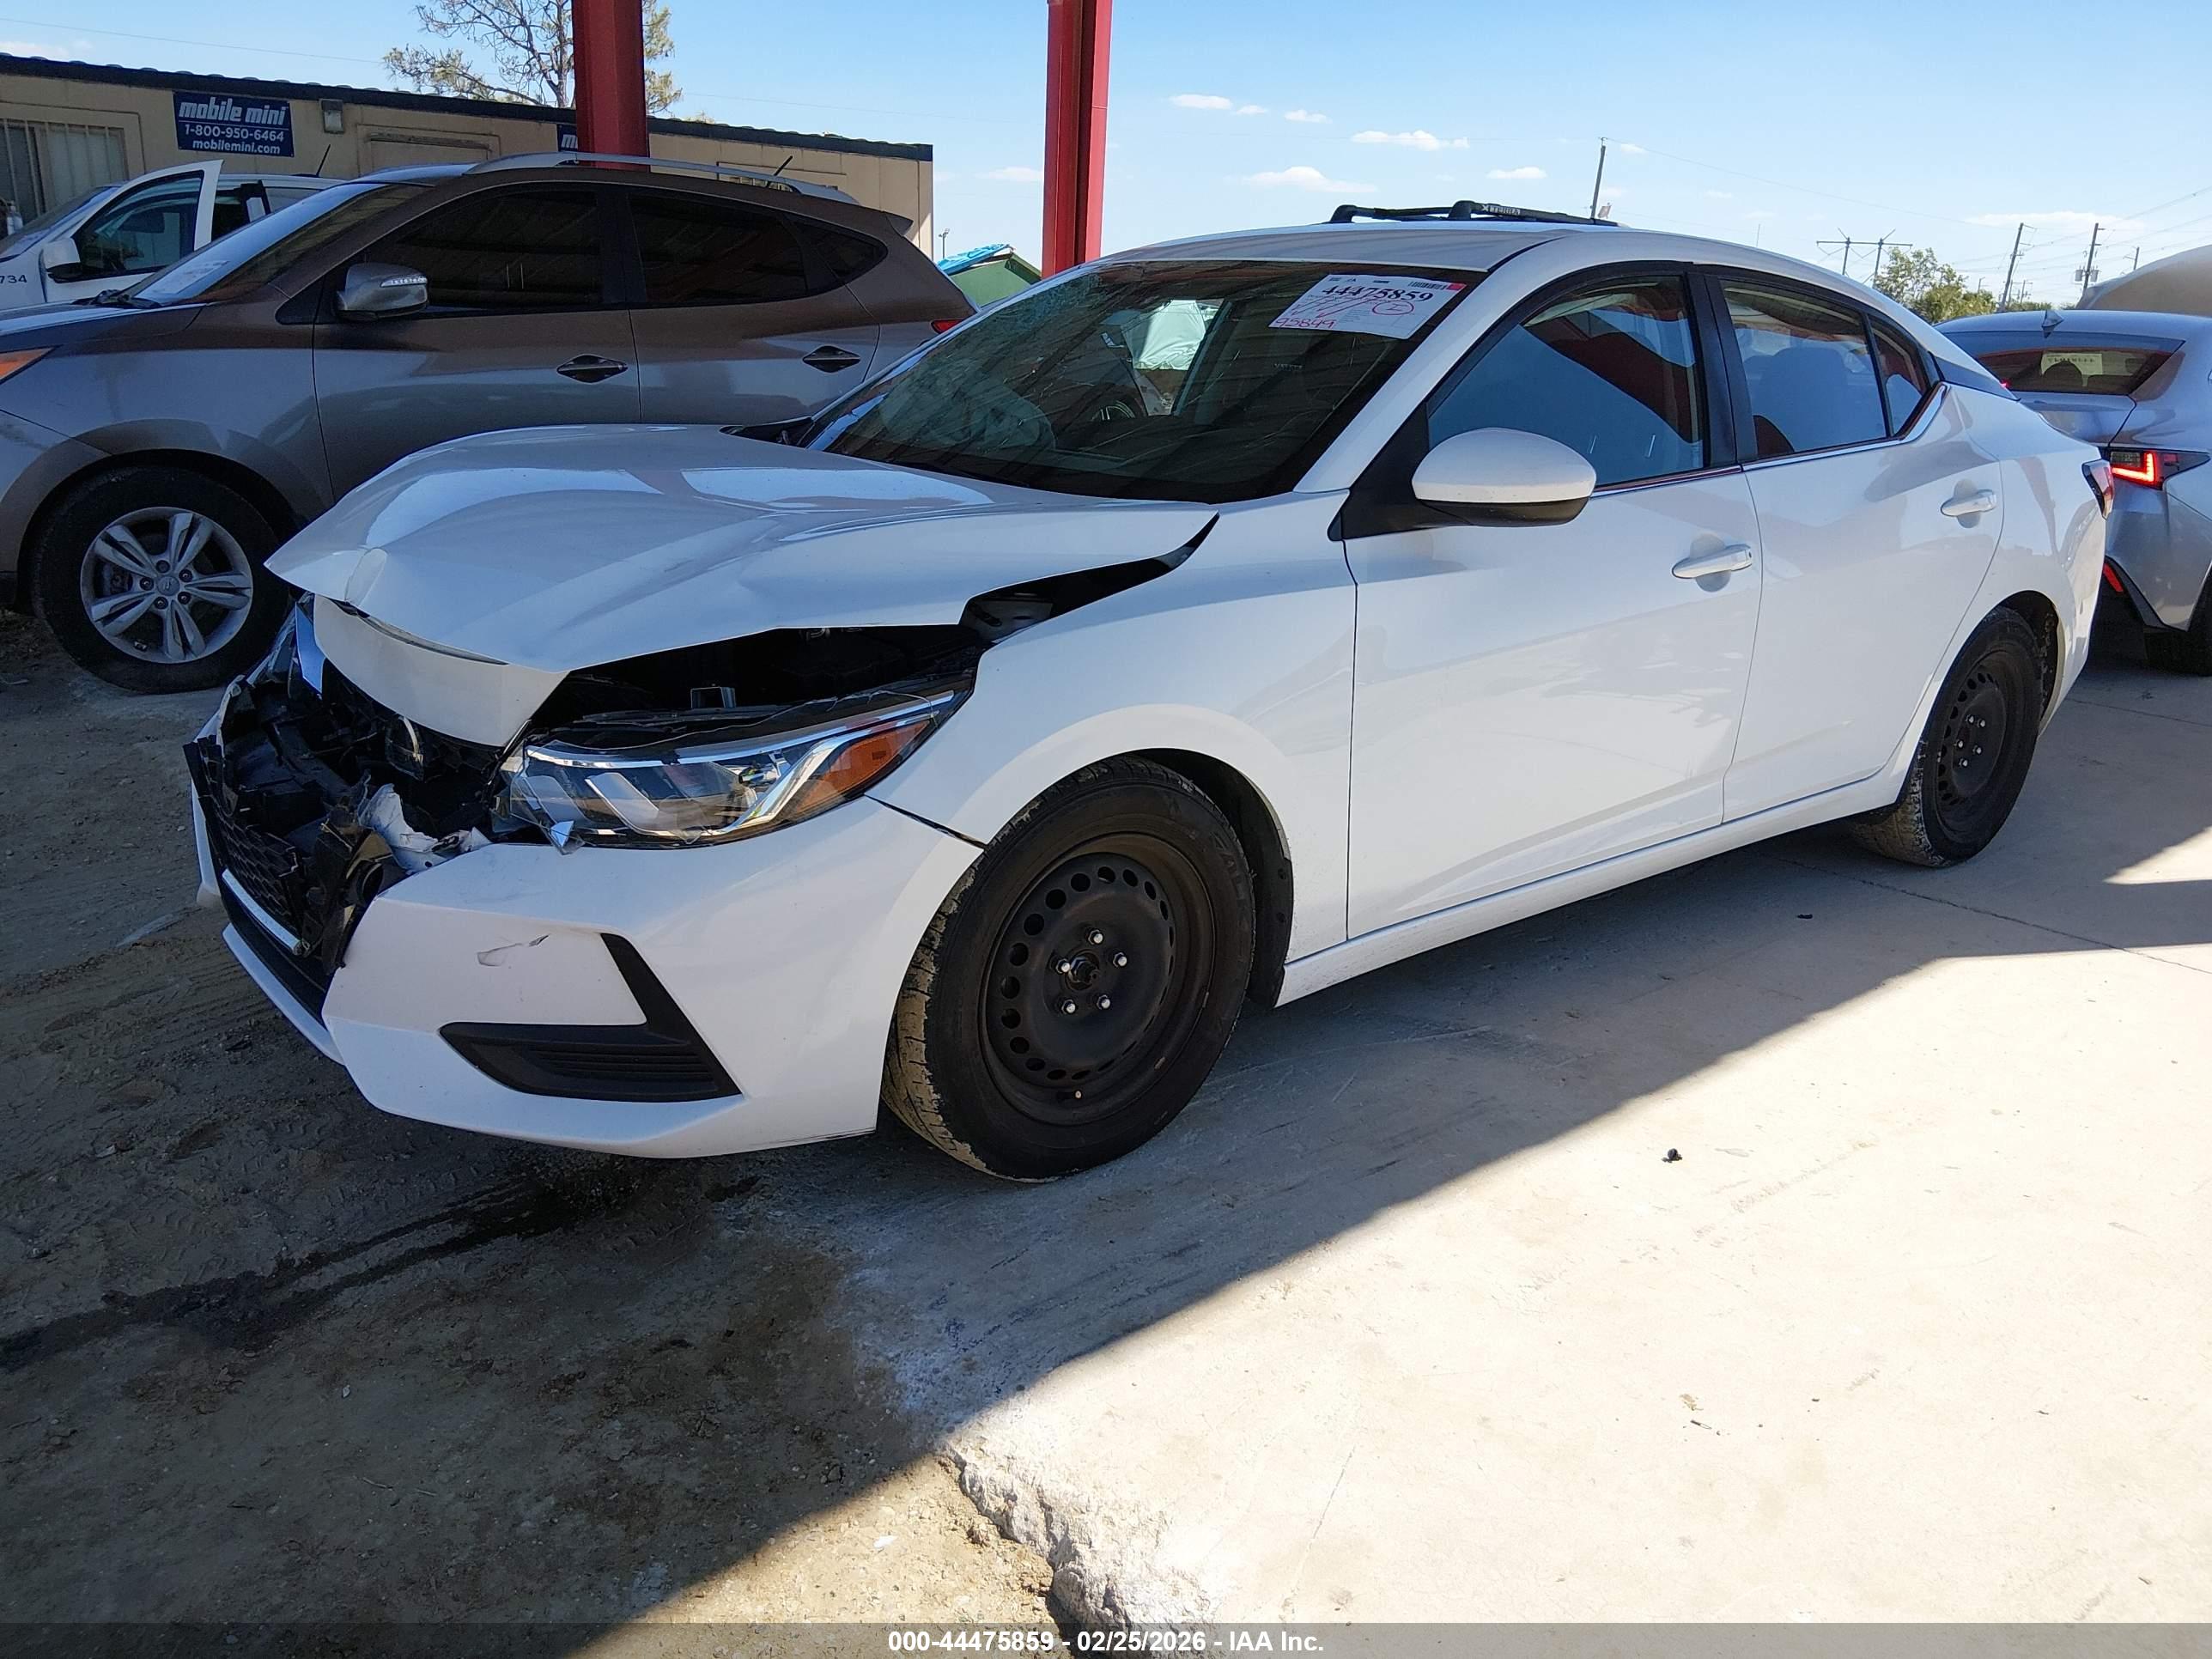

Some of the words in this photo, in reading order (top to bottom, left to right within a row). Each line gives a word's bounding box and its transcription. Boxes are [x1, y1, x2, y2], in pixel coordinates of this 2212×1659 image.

[179, 97, 242, 122] mobile
[245, 105, 287, 125] mini
[185, 124, 284, 142] 1-800-950-6464
[192, 139, 281, 155] mobilemini.com
[1322, 285, 1433, 301] 44475859
